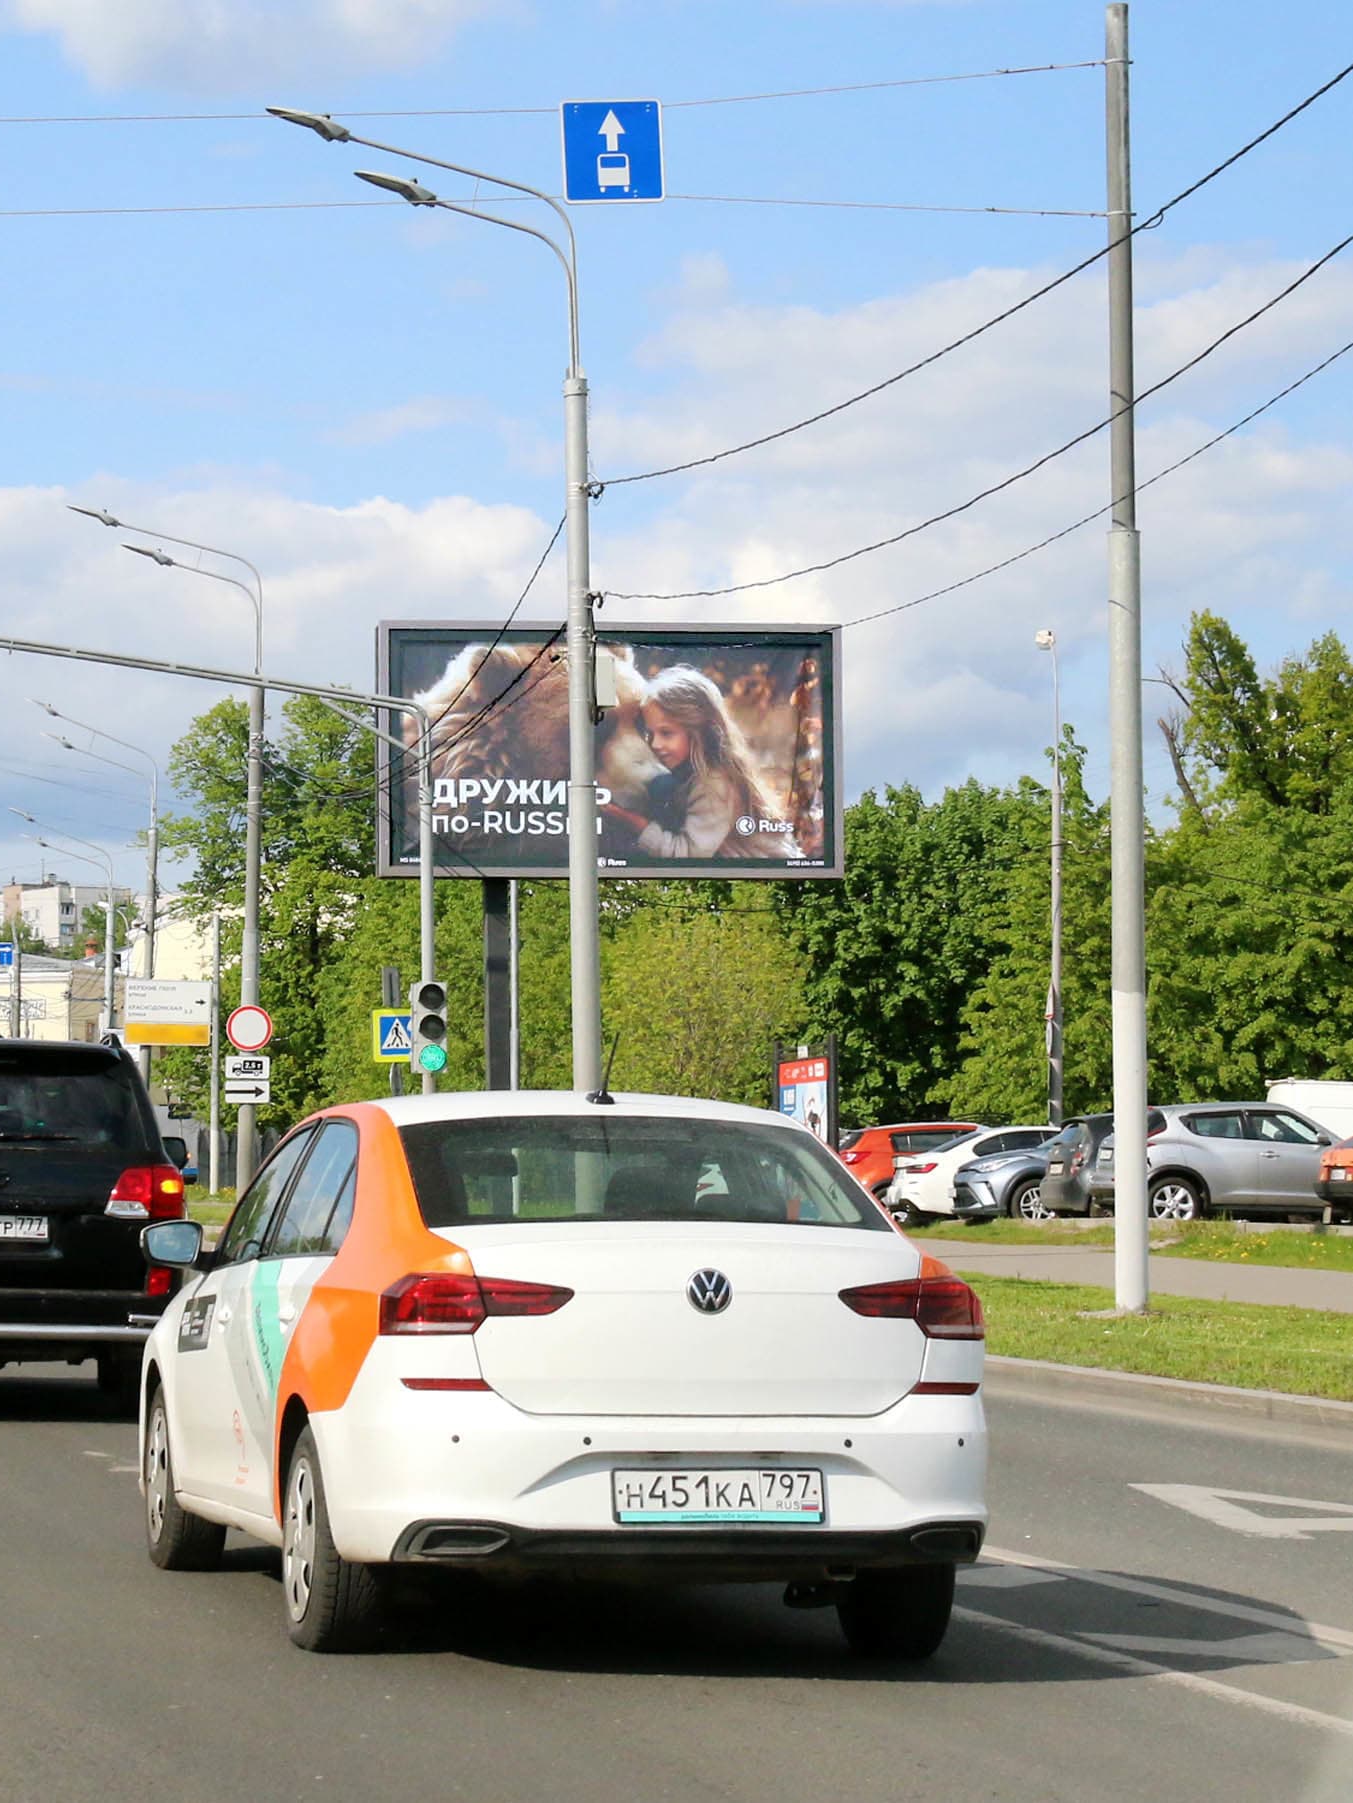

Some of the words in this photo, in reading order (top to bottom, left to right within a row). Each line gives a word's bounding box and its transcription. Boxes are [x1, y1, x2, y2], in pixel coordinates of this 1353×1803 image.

[432, 778, 612, 808] ДРУЖИЬ
[432, 810, 603, 835] по-RUSS
[758, 819, 794, 833] Russ
[17, 1217, 44, 1231] 777
[625, 1475, 756, 1509] Н451КА
[762, 1473, 811, 1499] 797
[776, 1501, 800, 1510] RUS
